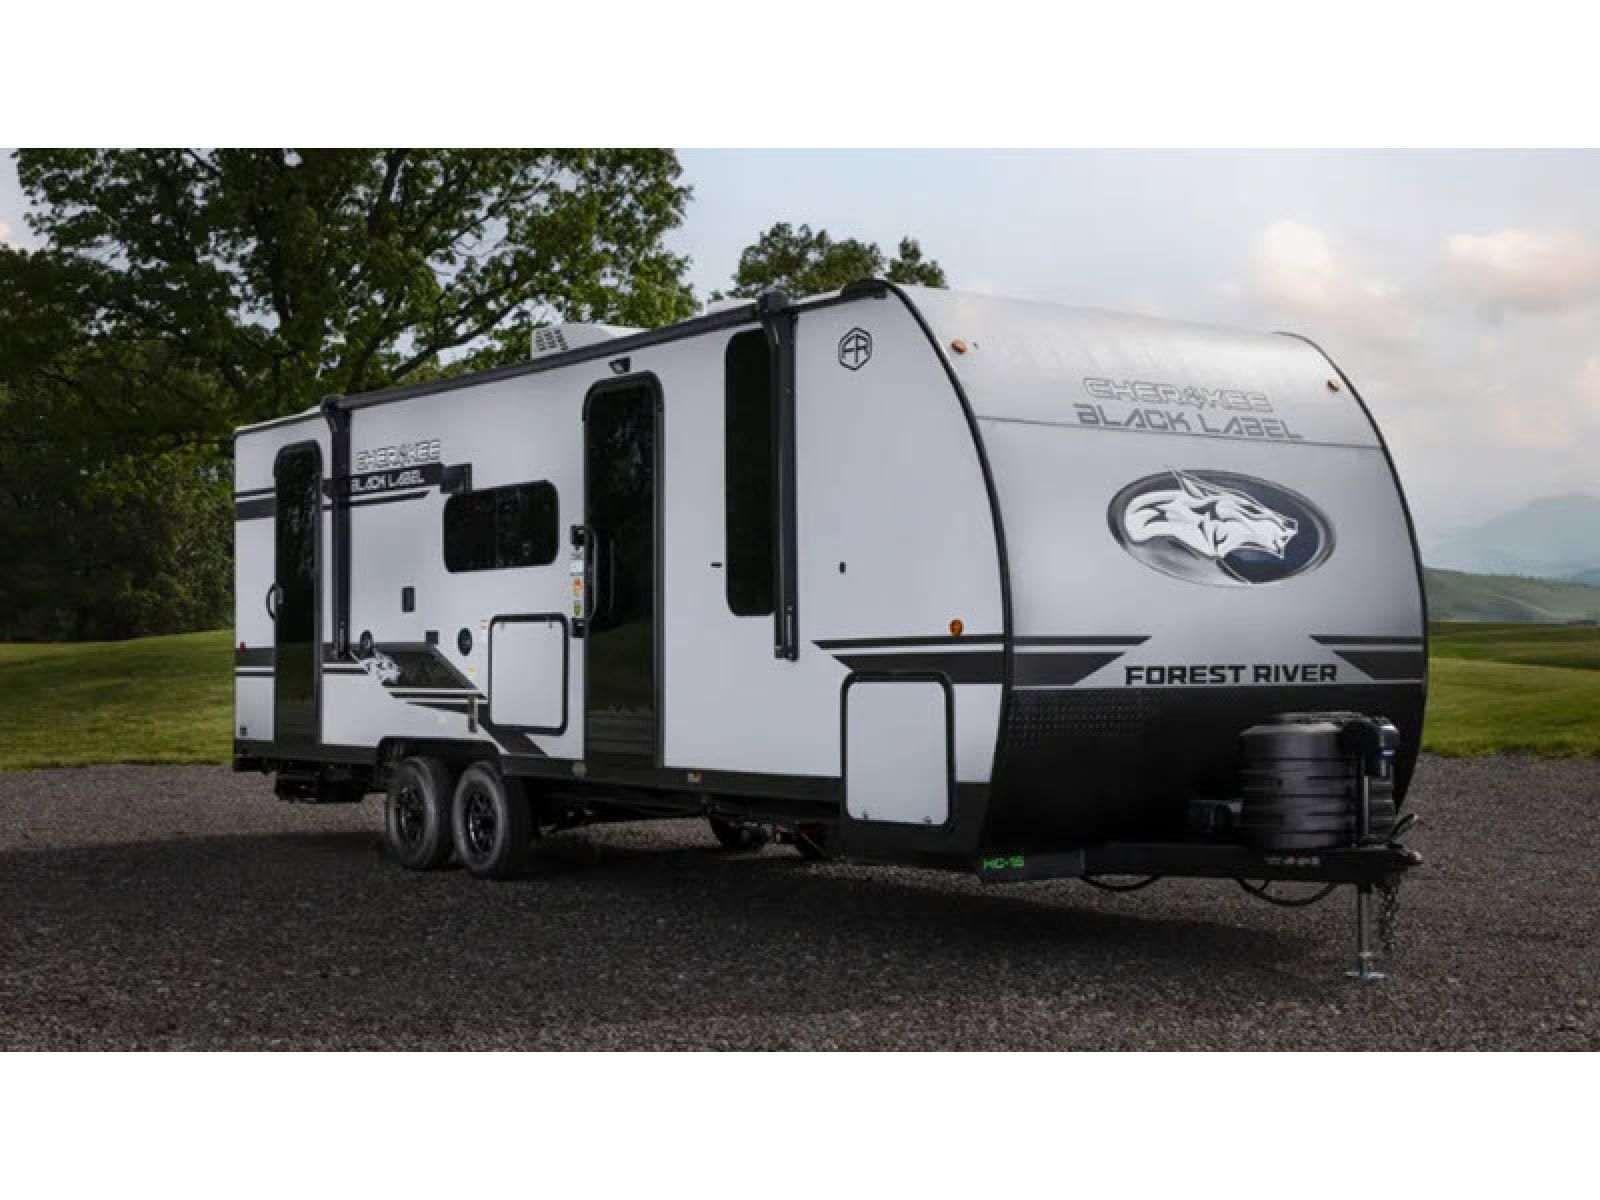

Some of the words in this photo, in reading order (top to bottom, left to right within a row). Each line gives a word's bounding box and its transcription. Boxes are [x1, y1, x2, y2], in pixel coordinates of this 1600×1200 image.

[1074, 402, 1192, 432] BLACK
[1197, 412, 1304, 440] LABEL
[1125, 665, 1246, 685] FOREST
[1253, 664, 1337, 683] RIVER
